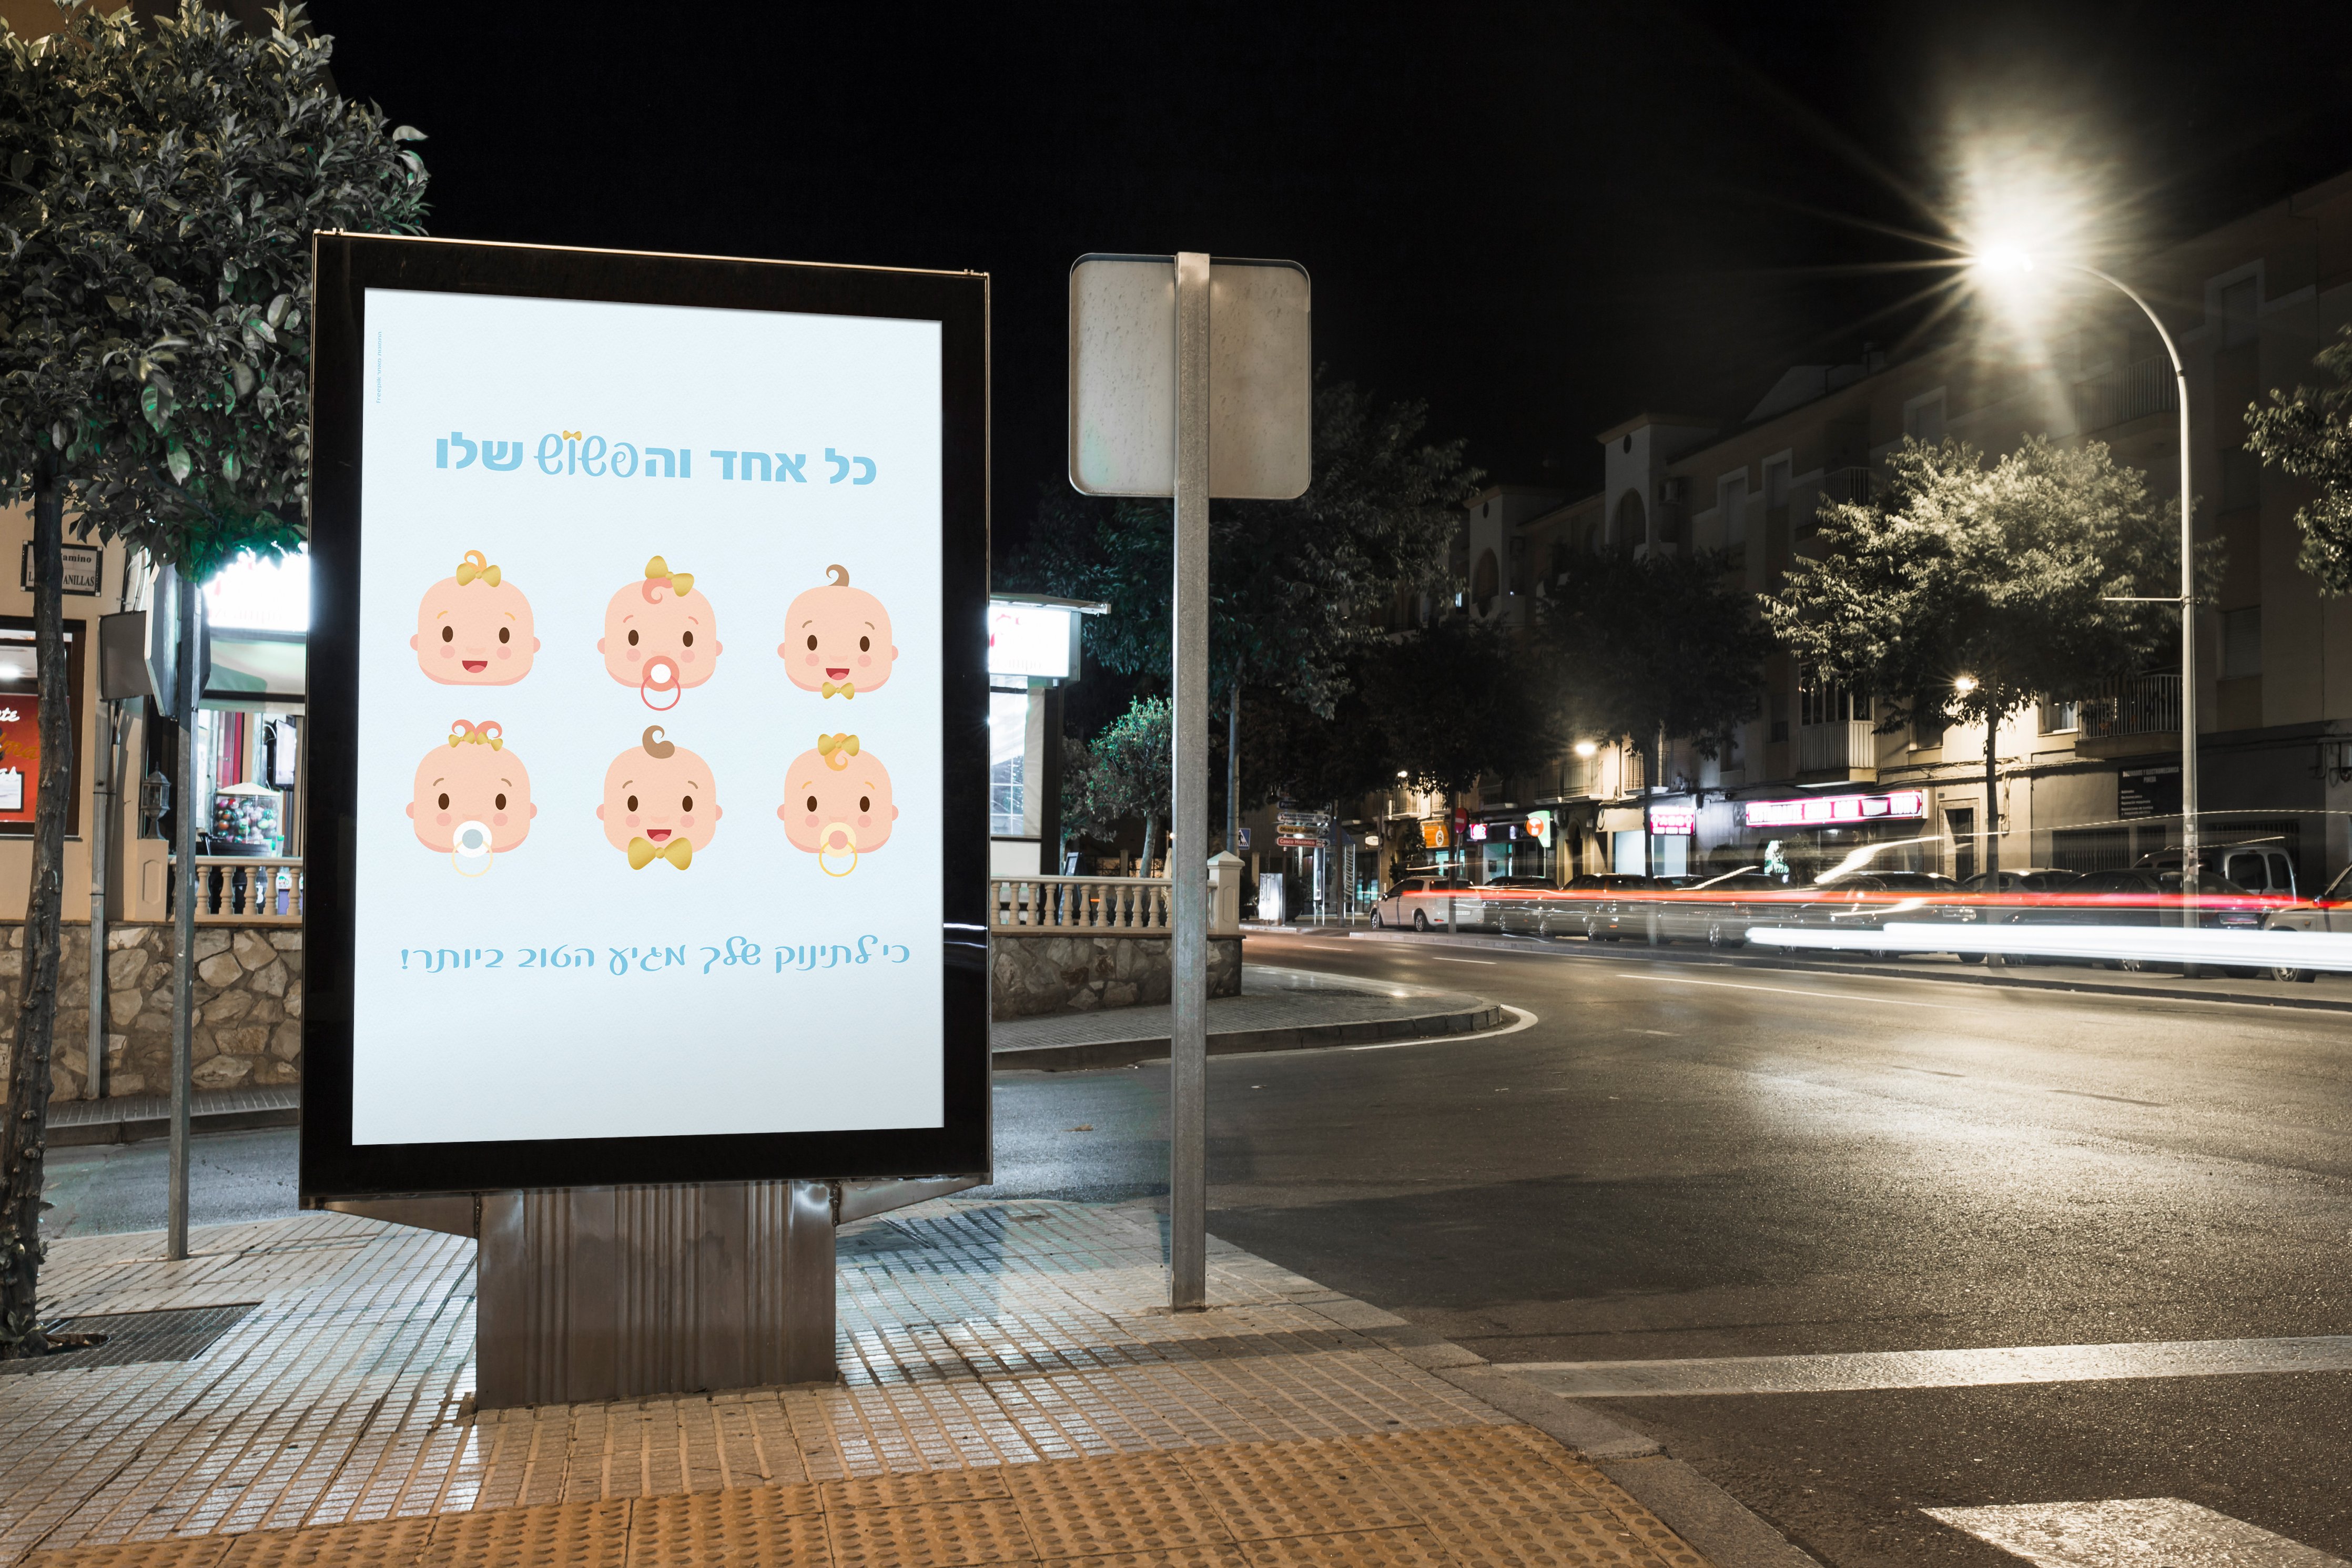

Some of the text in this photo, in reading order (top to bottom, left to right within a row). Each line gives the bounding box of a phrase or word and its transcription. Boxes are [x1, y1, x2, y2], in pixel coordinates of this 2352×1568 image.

[437, 431, 876, 485] כל אחד והפשוש שלו
[61, 554, 92, 563] amino
[401, 935, 910, 976] כי לתינוק שלך מגיע הטוב ביותר!
